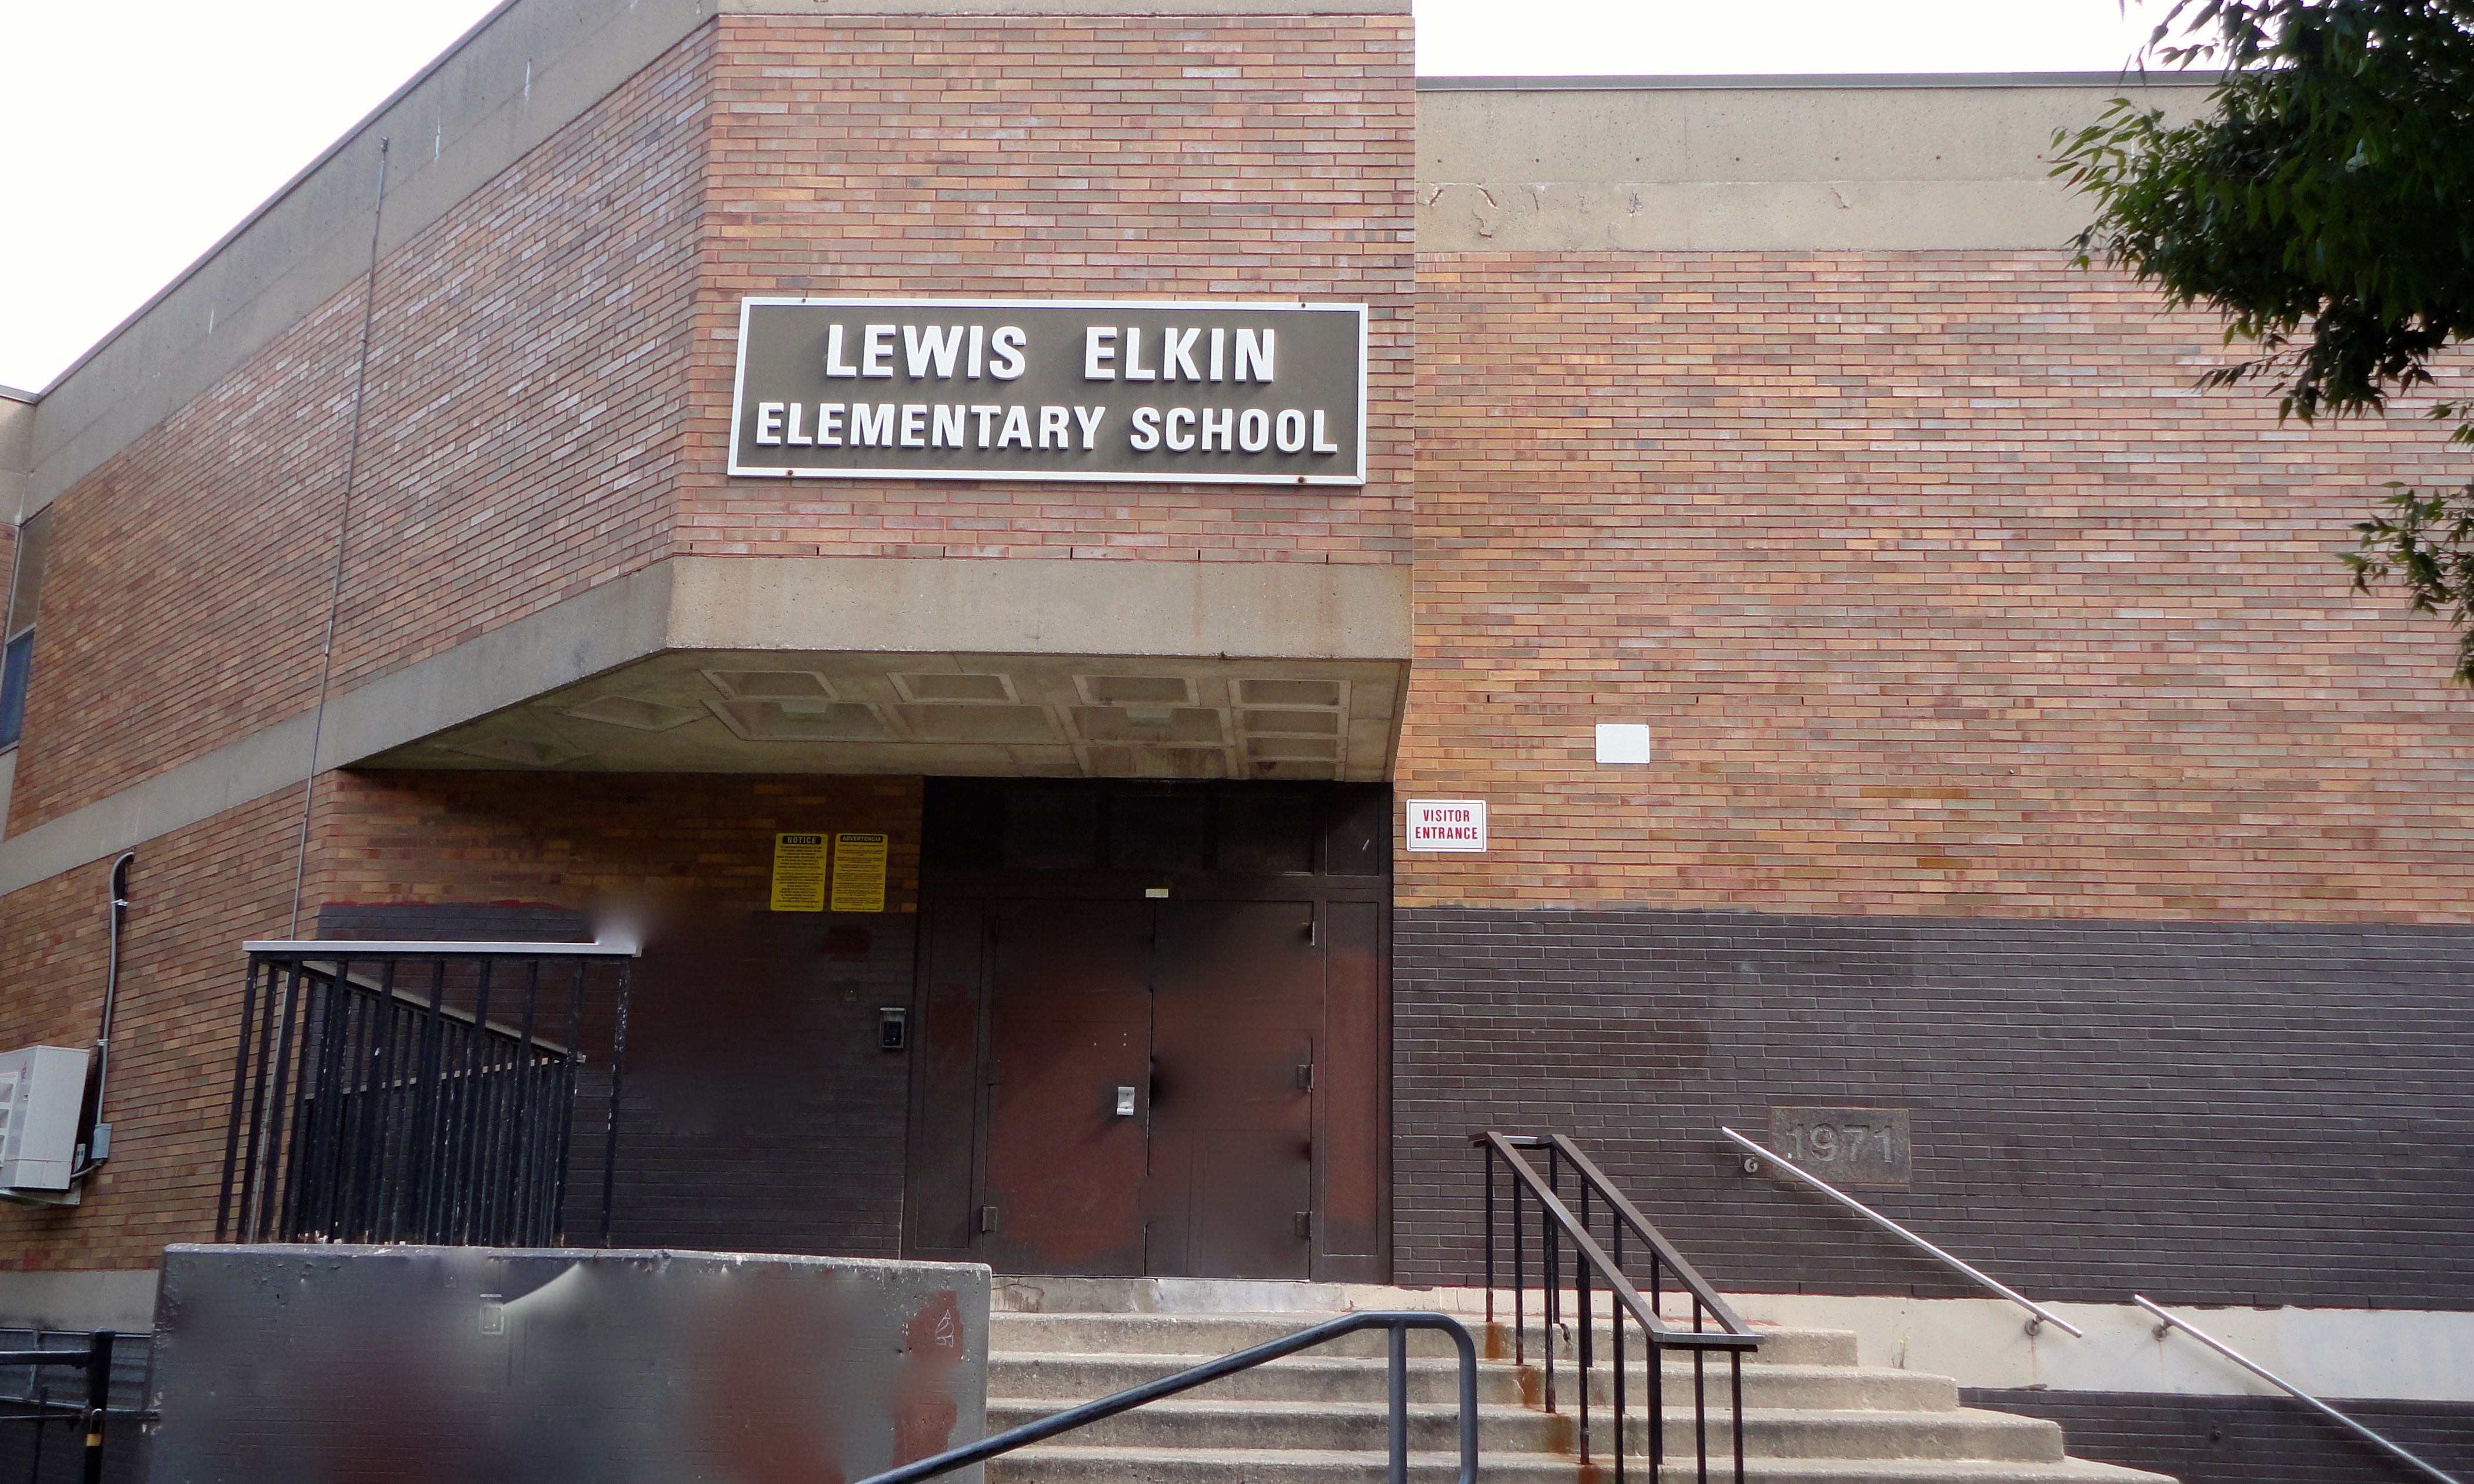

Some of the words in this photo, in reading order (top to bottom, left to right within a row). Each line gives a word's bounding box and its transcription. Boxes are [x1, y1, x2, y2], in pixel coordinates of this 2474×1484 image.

[825, 324, 1026, 380] LEWIS
[1084, 326, 1274, 382] ELKIN
[757, 402, 1106, 449] ELEMENTARY
[1130, 406, 1337, 453] SCHOOL
[1415, 826, 1478, 839] ENTRANCE
[1423, 809, 1470, 822] VISITOR
[1786, 1123, 1893, 1163] 1971
